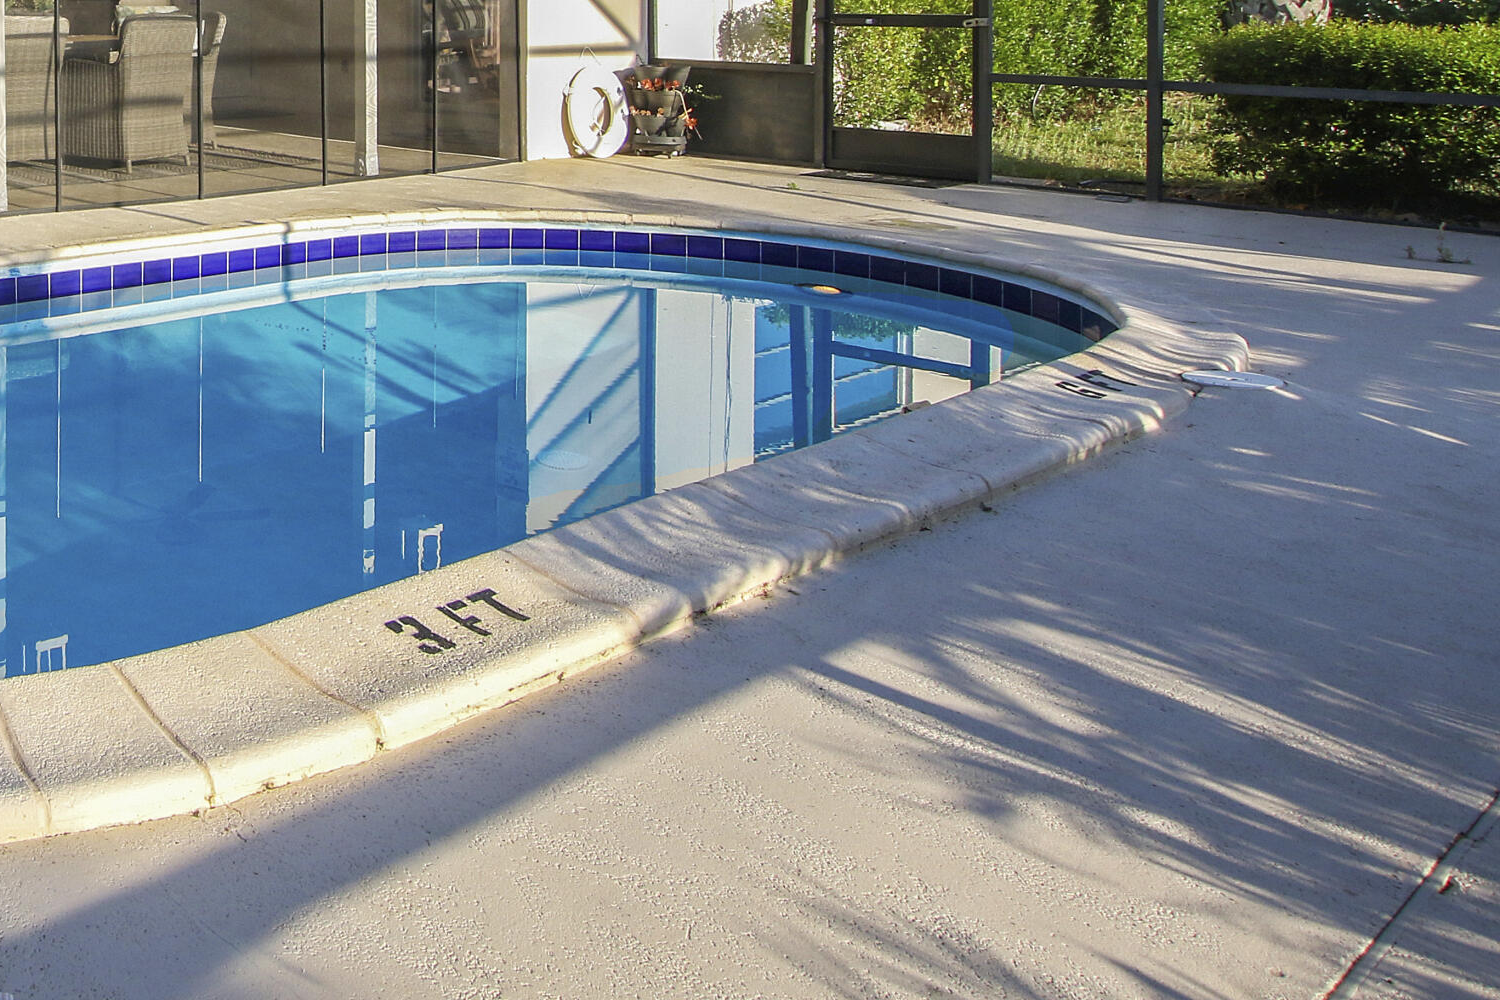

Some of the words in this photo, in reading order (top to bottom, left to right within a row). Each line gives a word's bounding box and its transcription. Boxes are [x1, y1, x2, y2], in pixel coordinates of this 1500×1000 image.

[1075, 369, 1138, 392] FT
[384, 615, 457, 655] 3
[435, 588, 532, 637] FT
